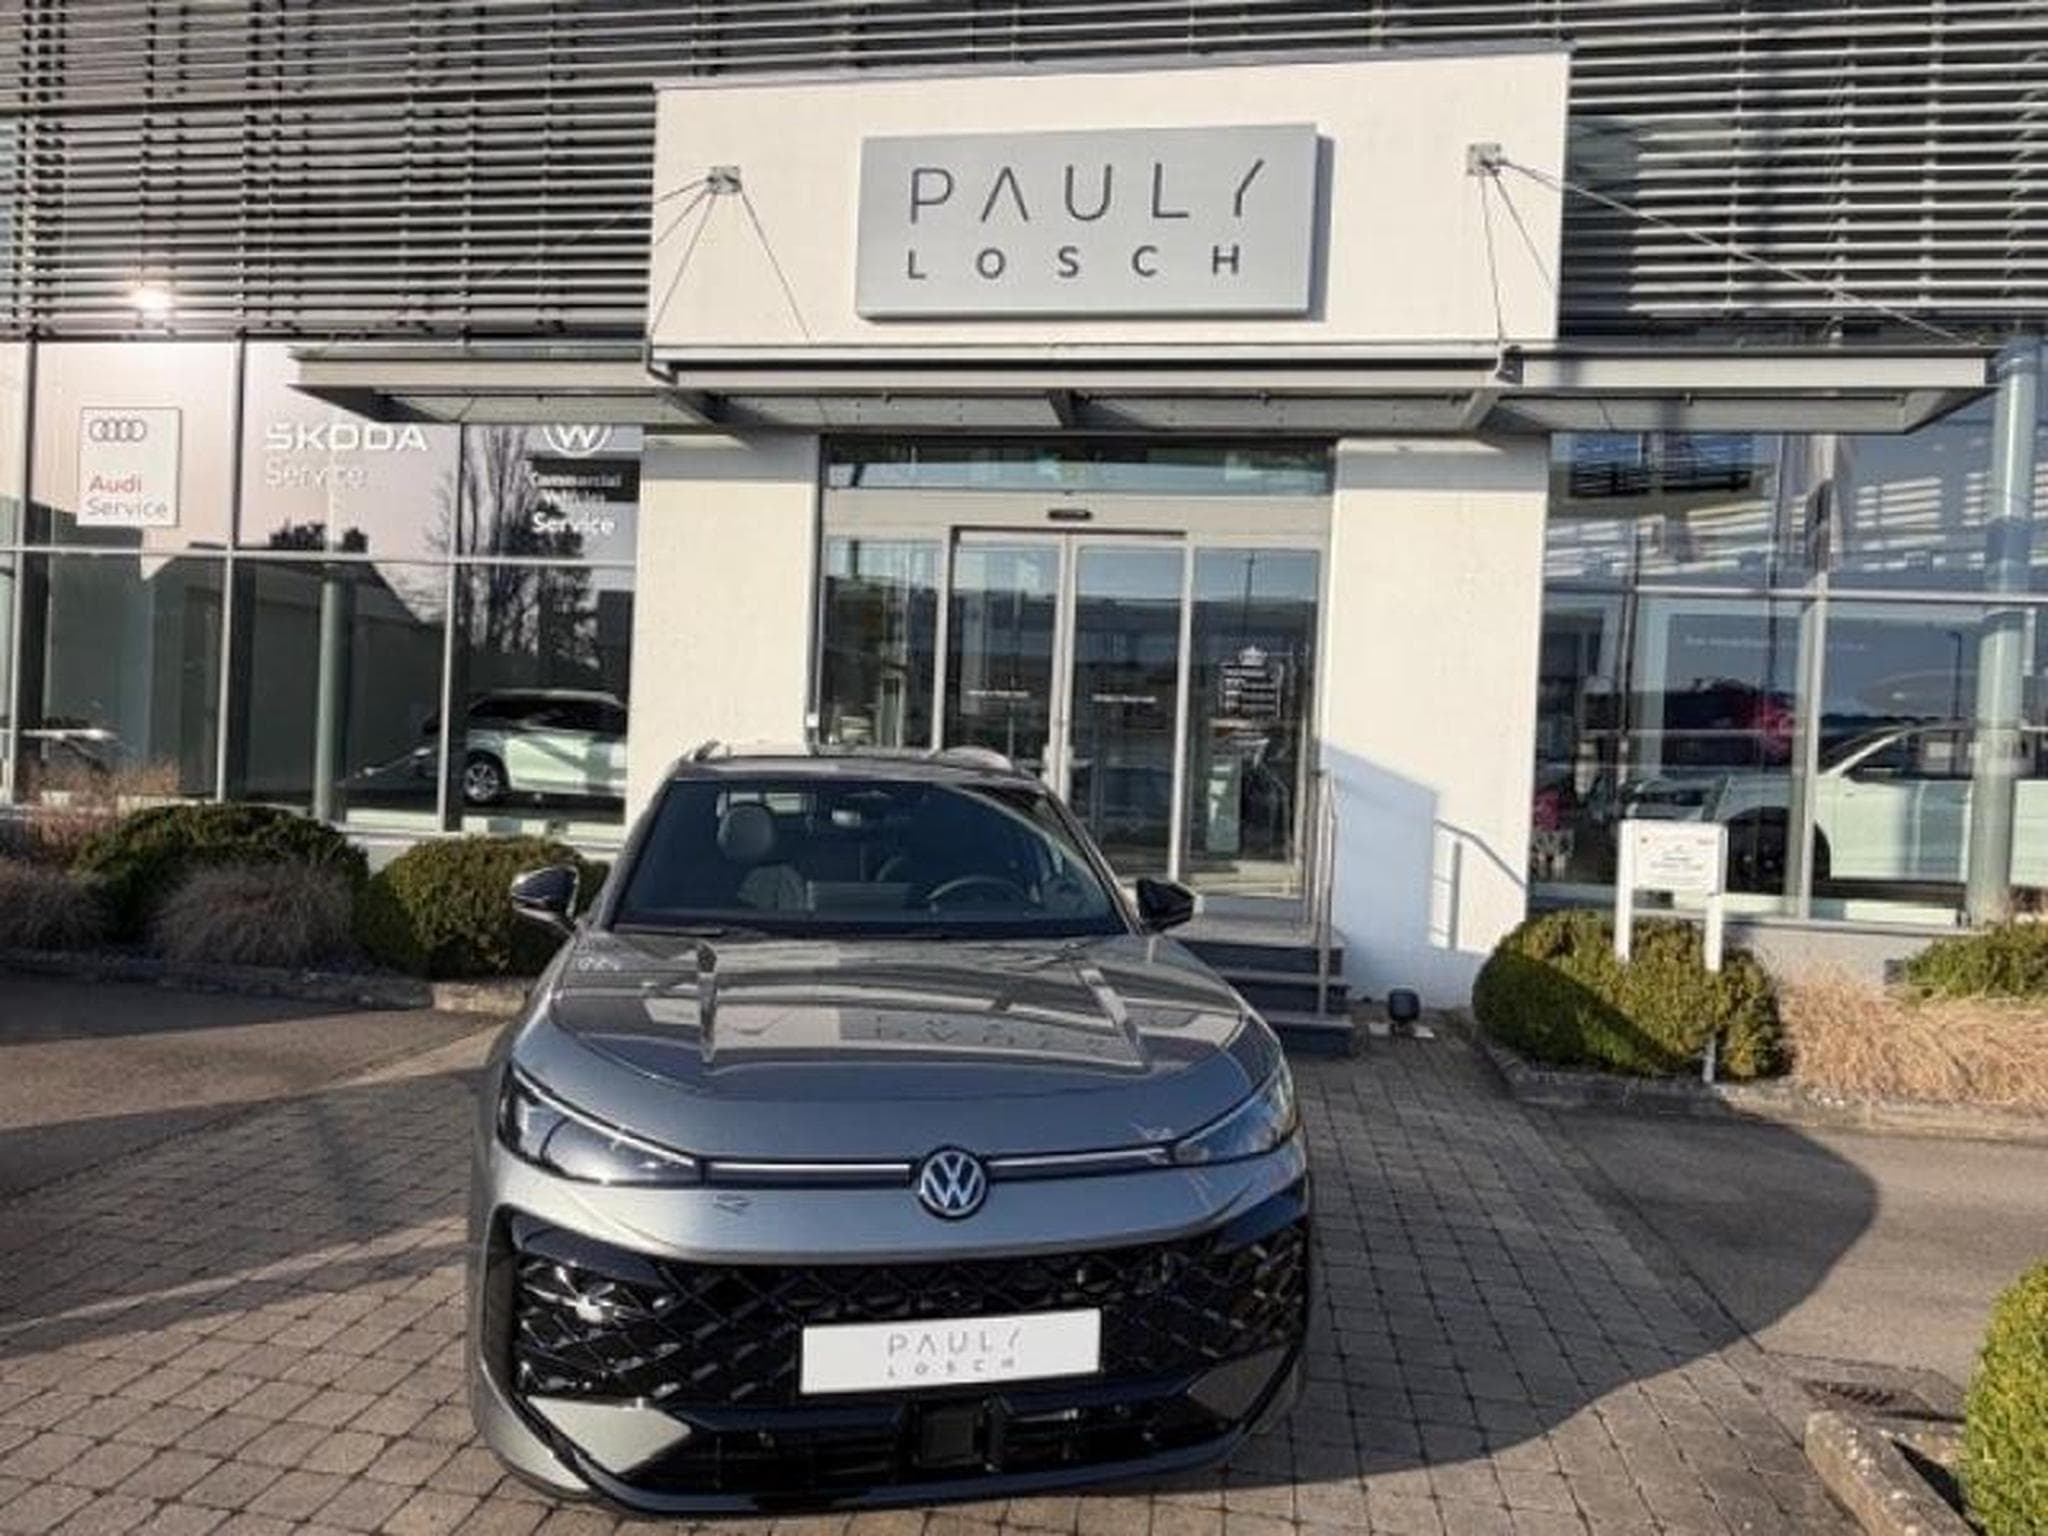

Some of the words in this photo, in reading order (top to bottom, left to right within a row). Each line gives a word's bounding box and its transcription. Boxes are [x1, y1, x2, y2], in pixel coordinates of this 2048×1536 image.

[909, 158, 1265, 225] PAULY
[906, 245, 1240, 280] LOSCH
[88, 473, 142, 494] Audi
[86, 497, 168, 517] Service
[531, 512, 616, 536] Service
[887, 1326, 1022, 1355] PAULY
[886, 1357, 1015, 1379] LOSCH
